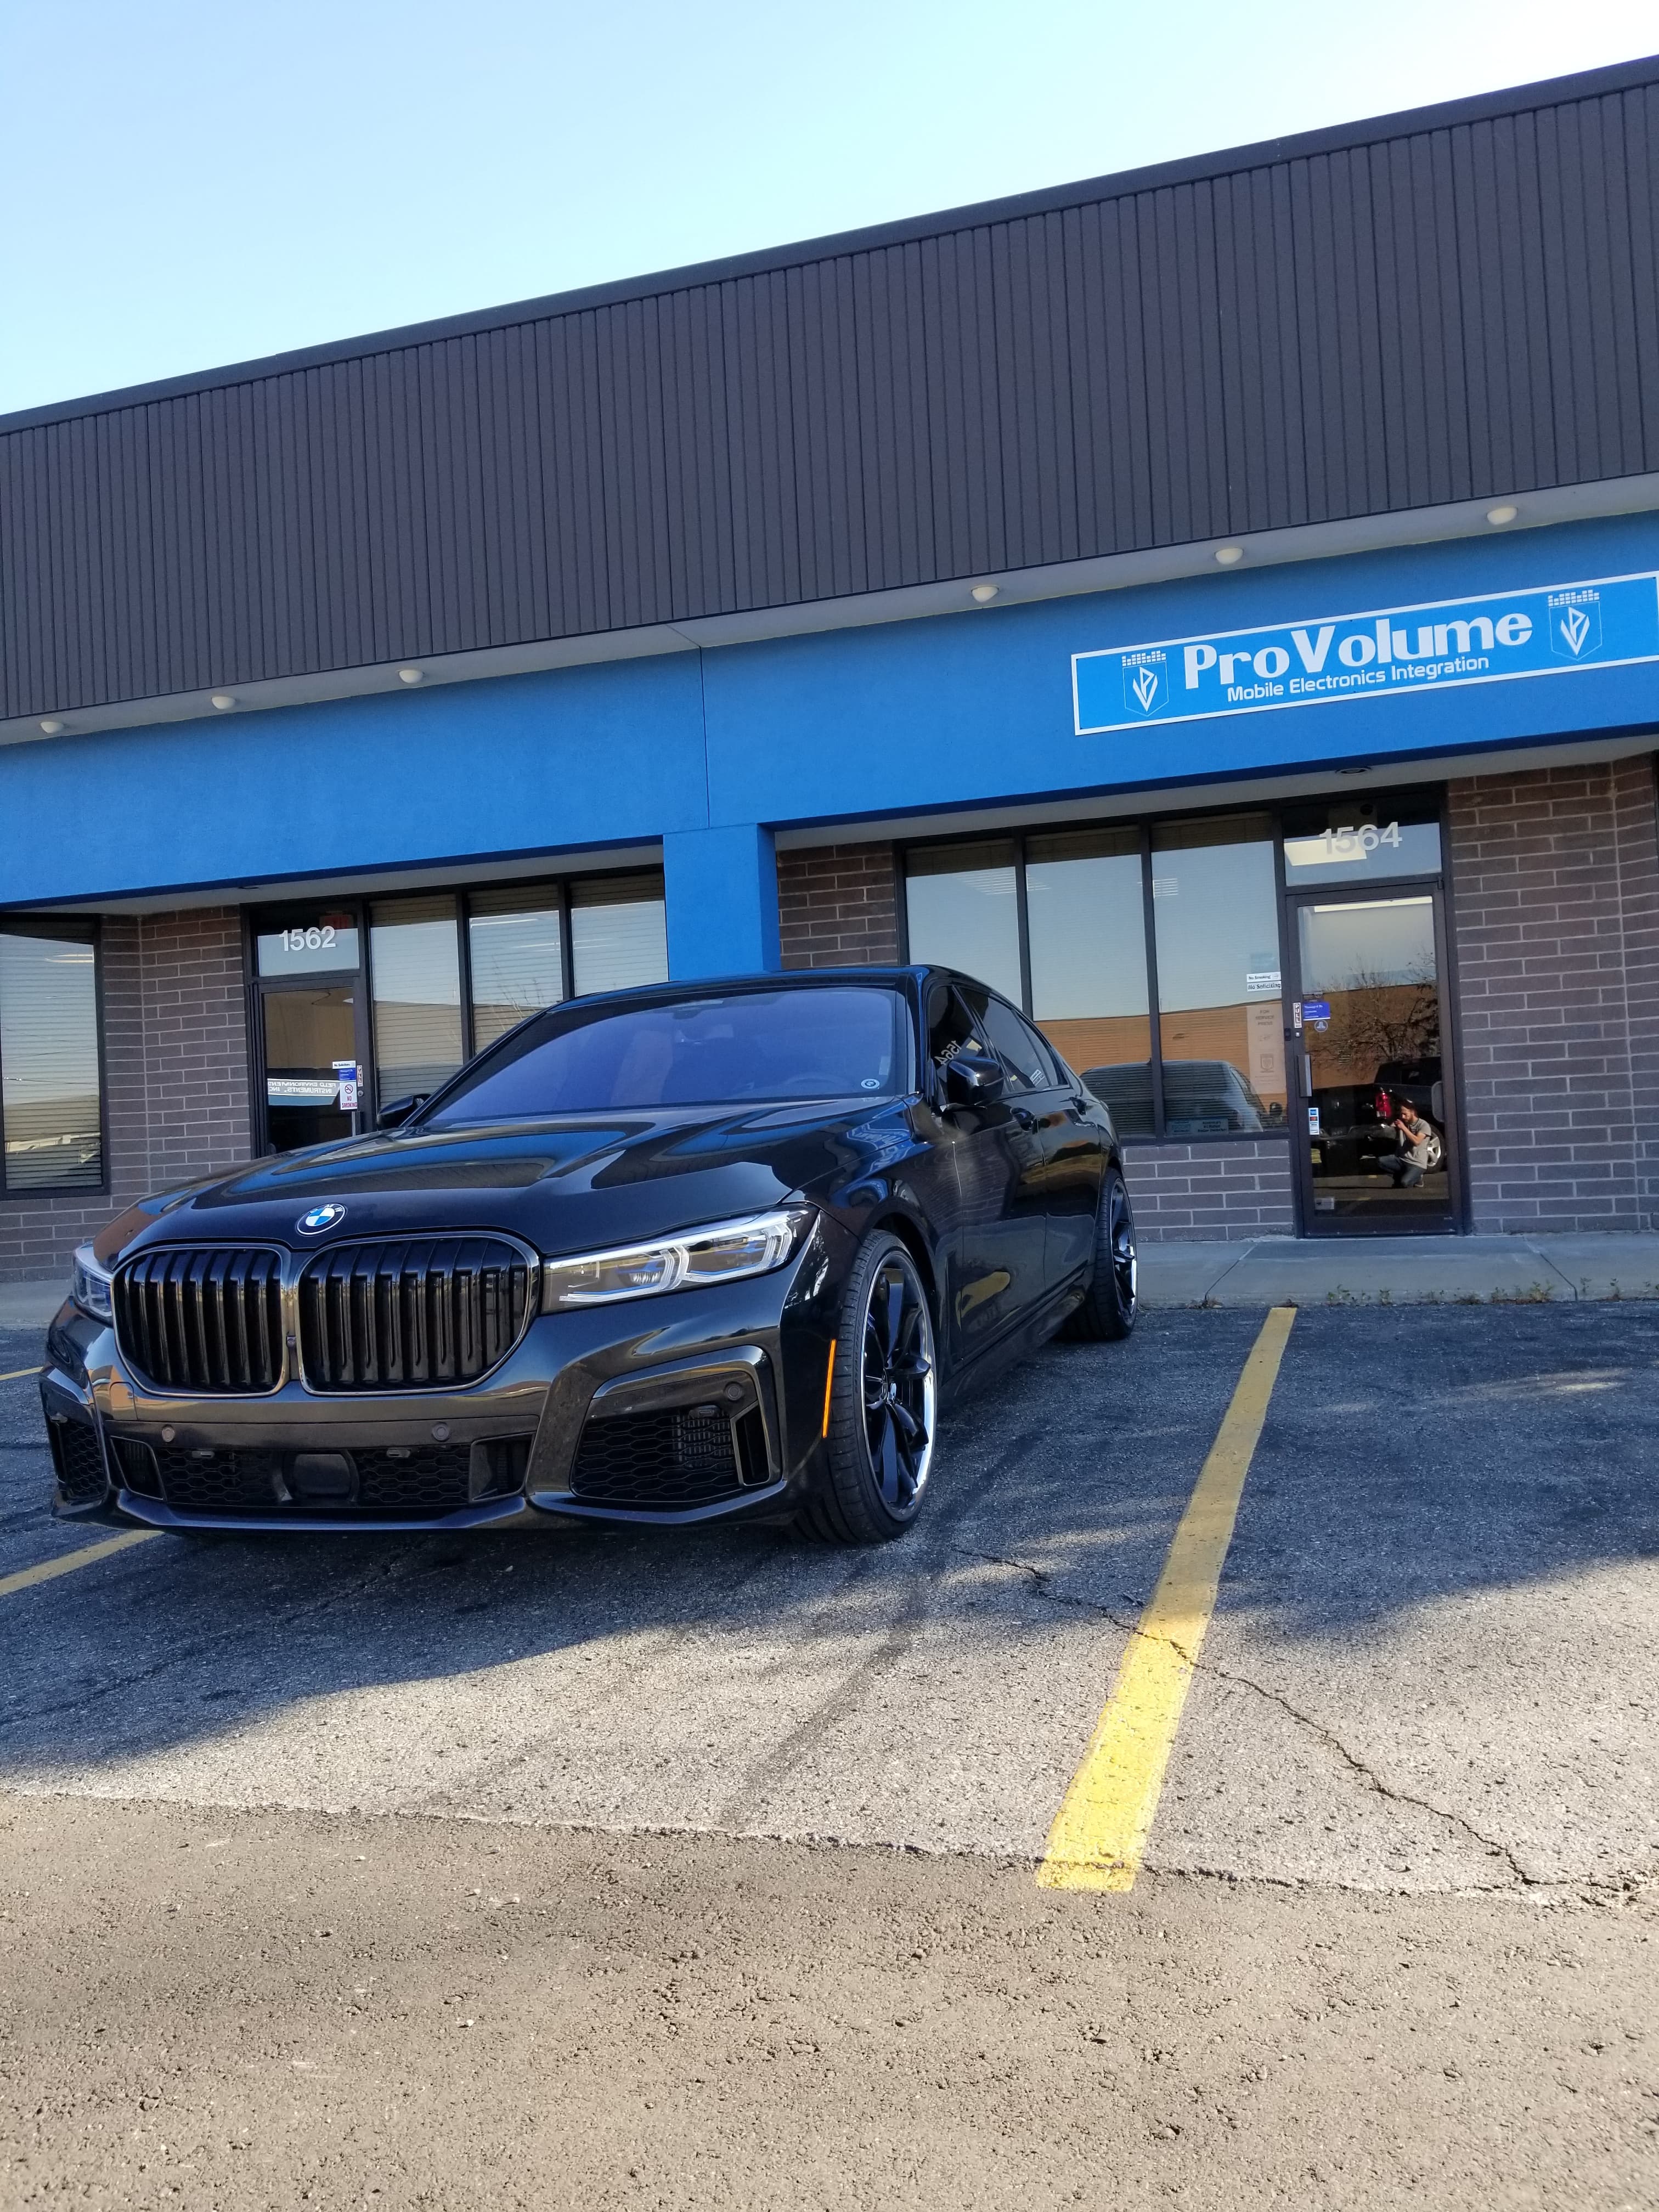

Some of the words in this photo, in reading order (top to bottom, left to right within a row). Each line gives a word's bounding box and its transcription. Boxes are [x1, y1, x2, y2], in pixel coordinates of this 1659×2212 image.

[1184, 613, 1533, 690] ProVolume
[1228, 682, 1284, 702] Mobile
[1289, 669, 1386, 694] Electronics
[1391, 656, 1489, 680] Integration
[1319, 822, 1402, 854] 1564
[279, 926, 336, 951] 1562
